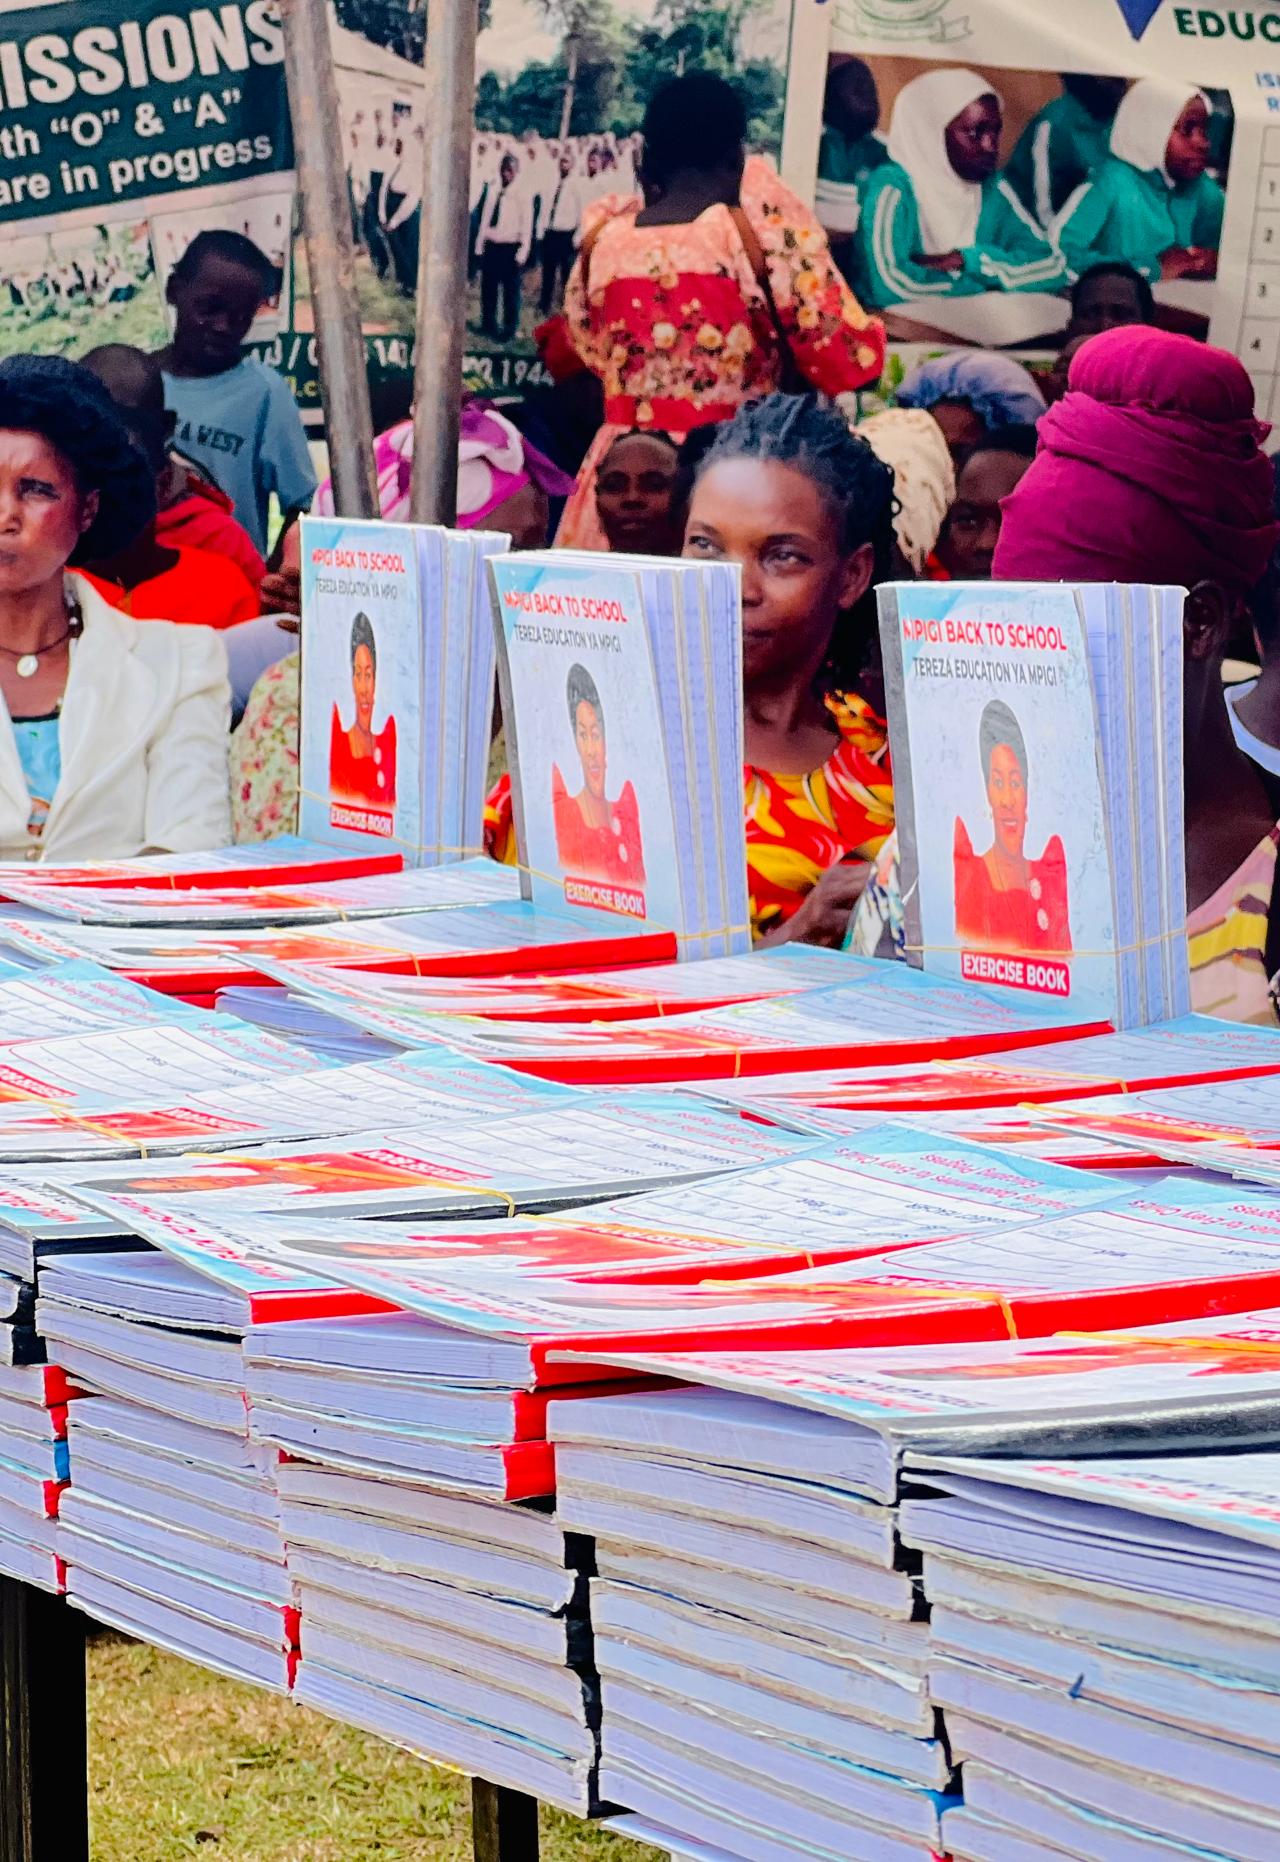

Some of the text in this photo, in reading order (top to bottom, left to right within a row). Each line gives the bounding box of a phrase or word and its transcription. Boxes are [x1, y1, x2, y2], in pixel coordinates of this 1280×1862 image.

[0, 0, 285, 112] ISSIONS
[134, 102, 165, 137] &
[60, 160, 98, 194] in
[108, 135, 273, 194] progress
[335, 549, 357, 569] BACK
[358, 551, 370, 569] TO
[370, 552, 406, 574] SCHOOL
[315, 577, 399, 600] TEREZA EDUCATION YA MPIGI
[534, 593, 561, 617] BACK
[563, 596, 581, 619] TO
[583, 597, 628, 624] SCHOOL
[513, 623, 623, 654] TEREZA EDUCATION YA MPIGI
[946, 622, 984, 646] BACK
[985, 623, 1006, 647] TO
[1008, 626, 1068, 652] SCHOOL
[913, 656, 1058, 687] TEREZA EDUCATION YA MPIGI
[330, 805, 393, 835] EXERCISE BOOK
[564, 881, 645, 916] EXERCISE BOOK
[962, 955, 1068, 991] EXERCISE BOOK
